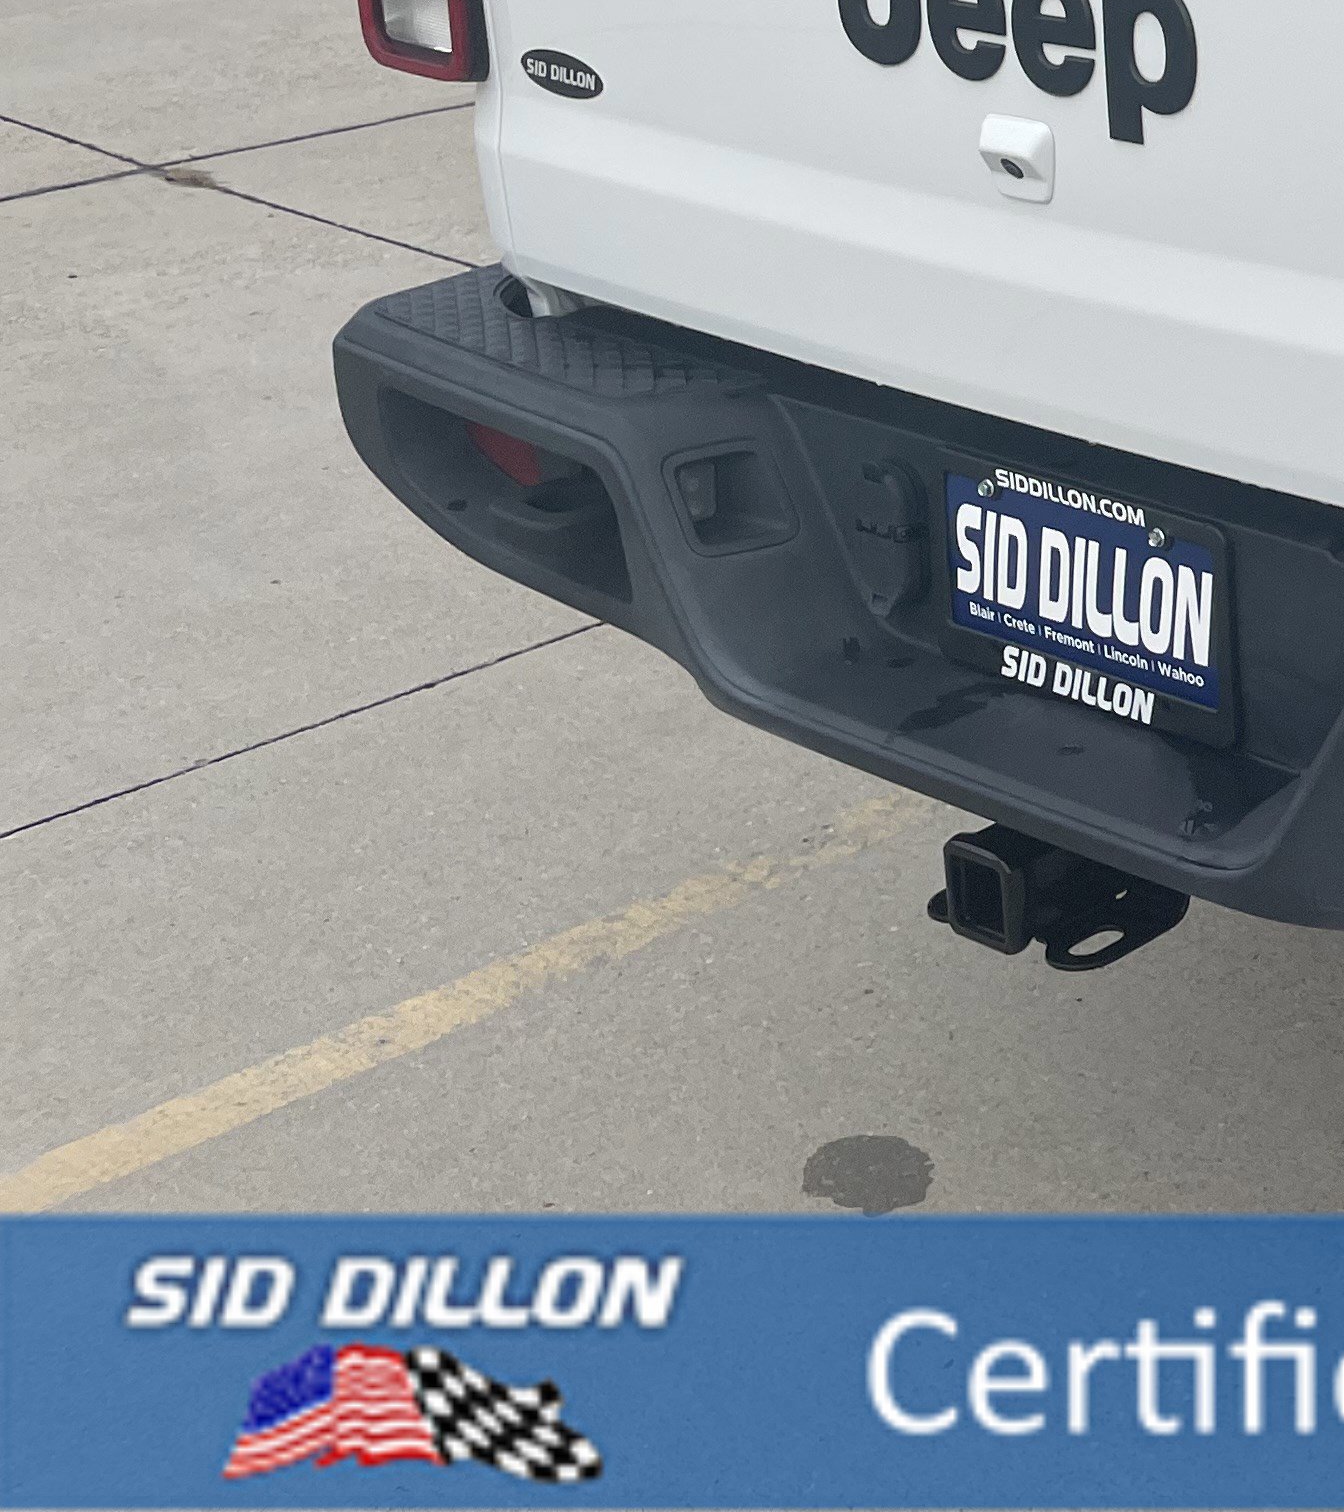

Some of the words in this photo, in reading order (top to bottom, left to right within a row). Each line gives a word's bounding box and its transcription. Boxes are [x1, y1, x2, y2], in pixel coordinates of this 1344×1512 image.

[526, 58, 547, 78] SID
[550, 63, 596, 91] DILLON
[994, 468, 1145, 526] SIDDILLON.COM
[956, 502, 1026, 608] SID
[1038, 526, 1212, 666] DILLON
[969, 601, 994, 621] Blair
[1003, 614, 1034, 634] Crete
[1044, 626, 1094, 653] Fremont
[1103, 643, 1147, 670] Lincoln
[1157, 661, 1204, 686] Wahoo
[1000, 644, 1046, 686] SID
[1052, 660, 1154, 724] DILLON
